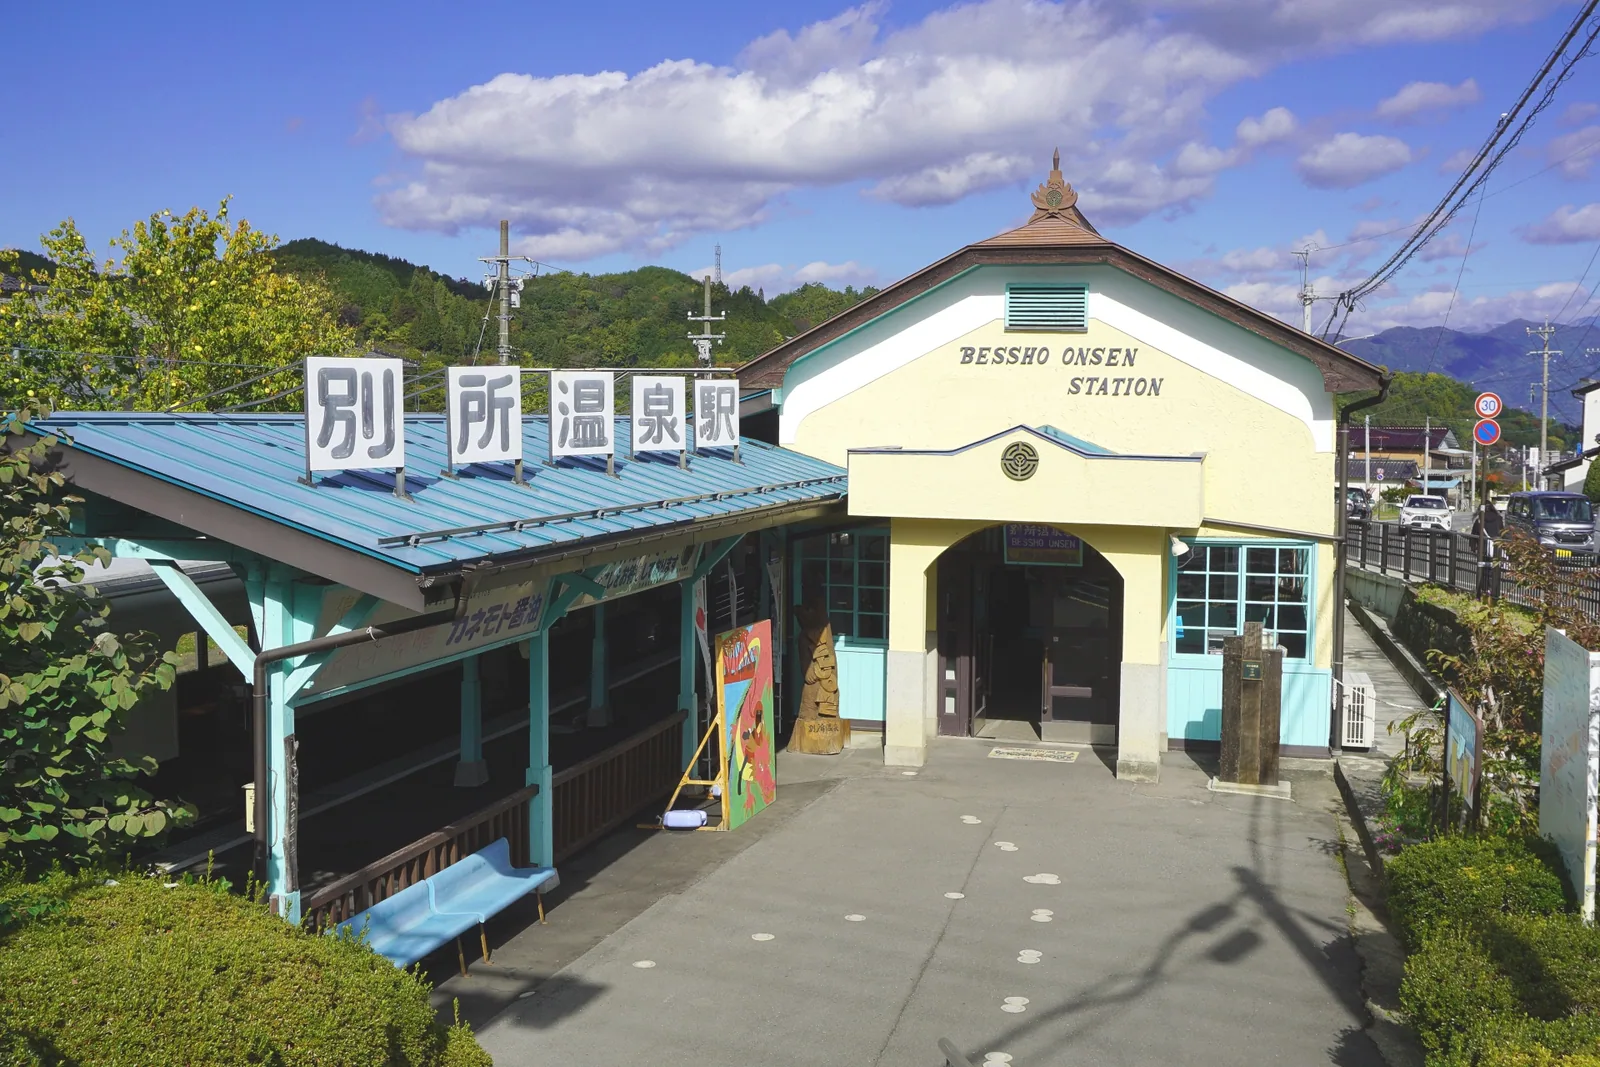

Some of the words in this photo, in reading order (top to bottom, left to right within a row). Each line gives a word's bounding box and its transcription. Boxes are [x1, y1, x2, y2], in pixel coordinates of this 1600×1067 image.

[960, 346, 1049, 365] BESSHO
[1062, 347, 1138, 367] ONSEN
[1067, 377, 1164, 396] STATION
[317, 367, 735, 459] 別所温泉駅
[1481, 400, 1496, 411] 30
[1011, 538, 1044, 547] BESSHO
[446, 593, 541, 646] カネモト醤油
